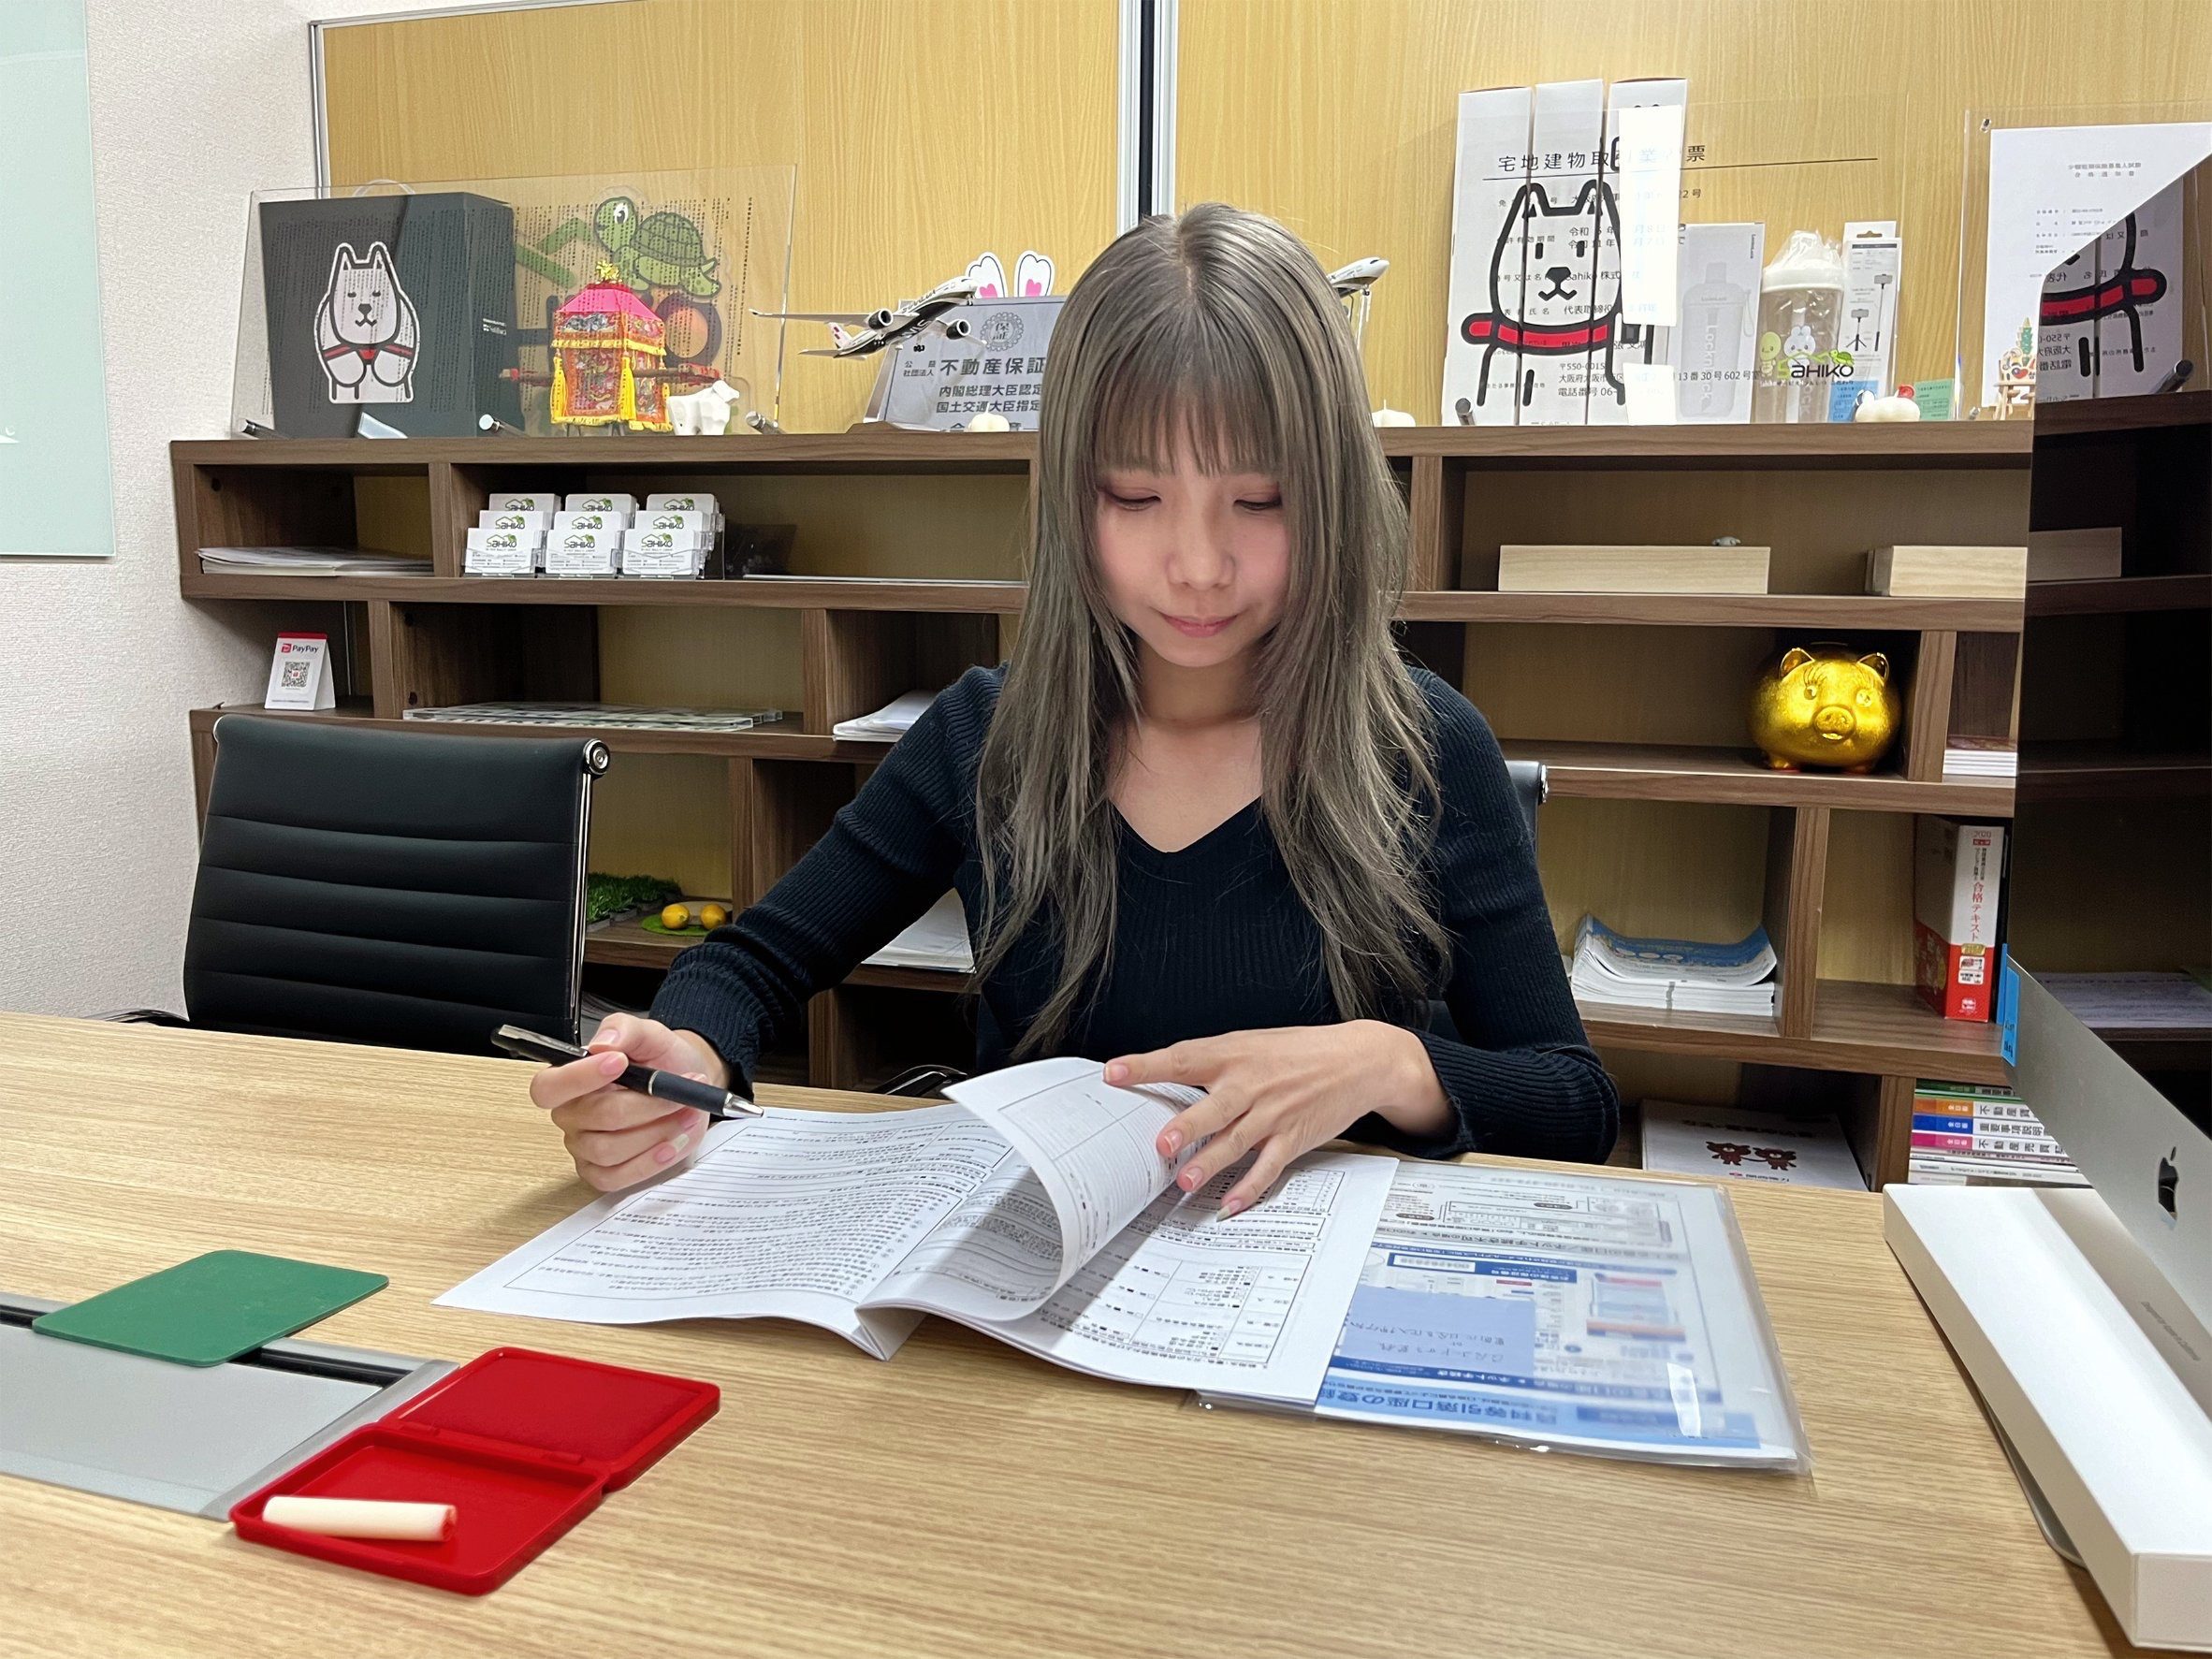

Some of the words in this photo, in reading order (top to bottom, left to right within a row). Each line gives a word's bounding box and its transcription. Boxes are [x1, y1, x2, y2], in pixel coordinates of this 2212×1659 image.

[1498, 144, 1706, 172] 宅地建物取業票
[903, 369, 934, 377] 社団法人
[939, 384, 1043, 398] 内閣総理大臣認定
[936, 400, 1041, 414] 国土交通大臣指定
[292, 645, 319, 653] PayPay
[1970, 881, 1984, 942] 合格テキスト
